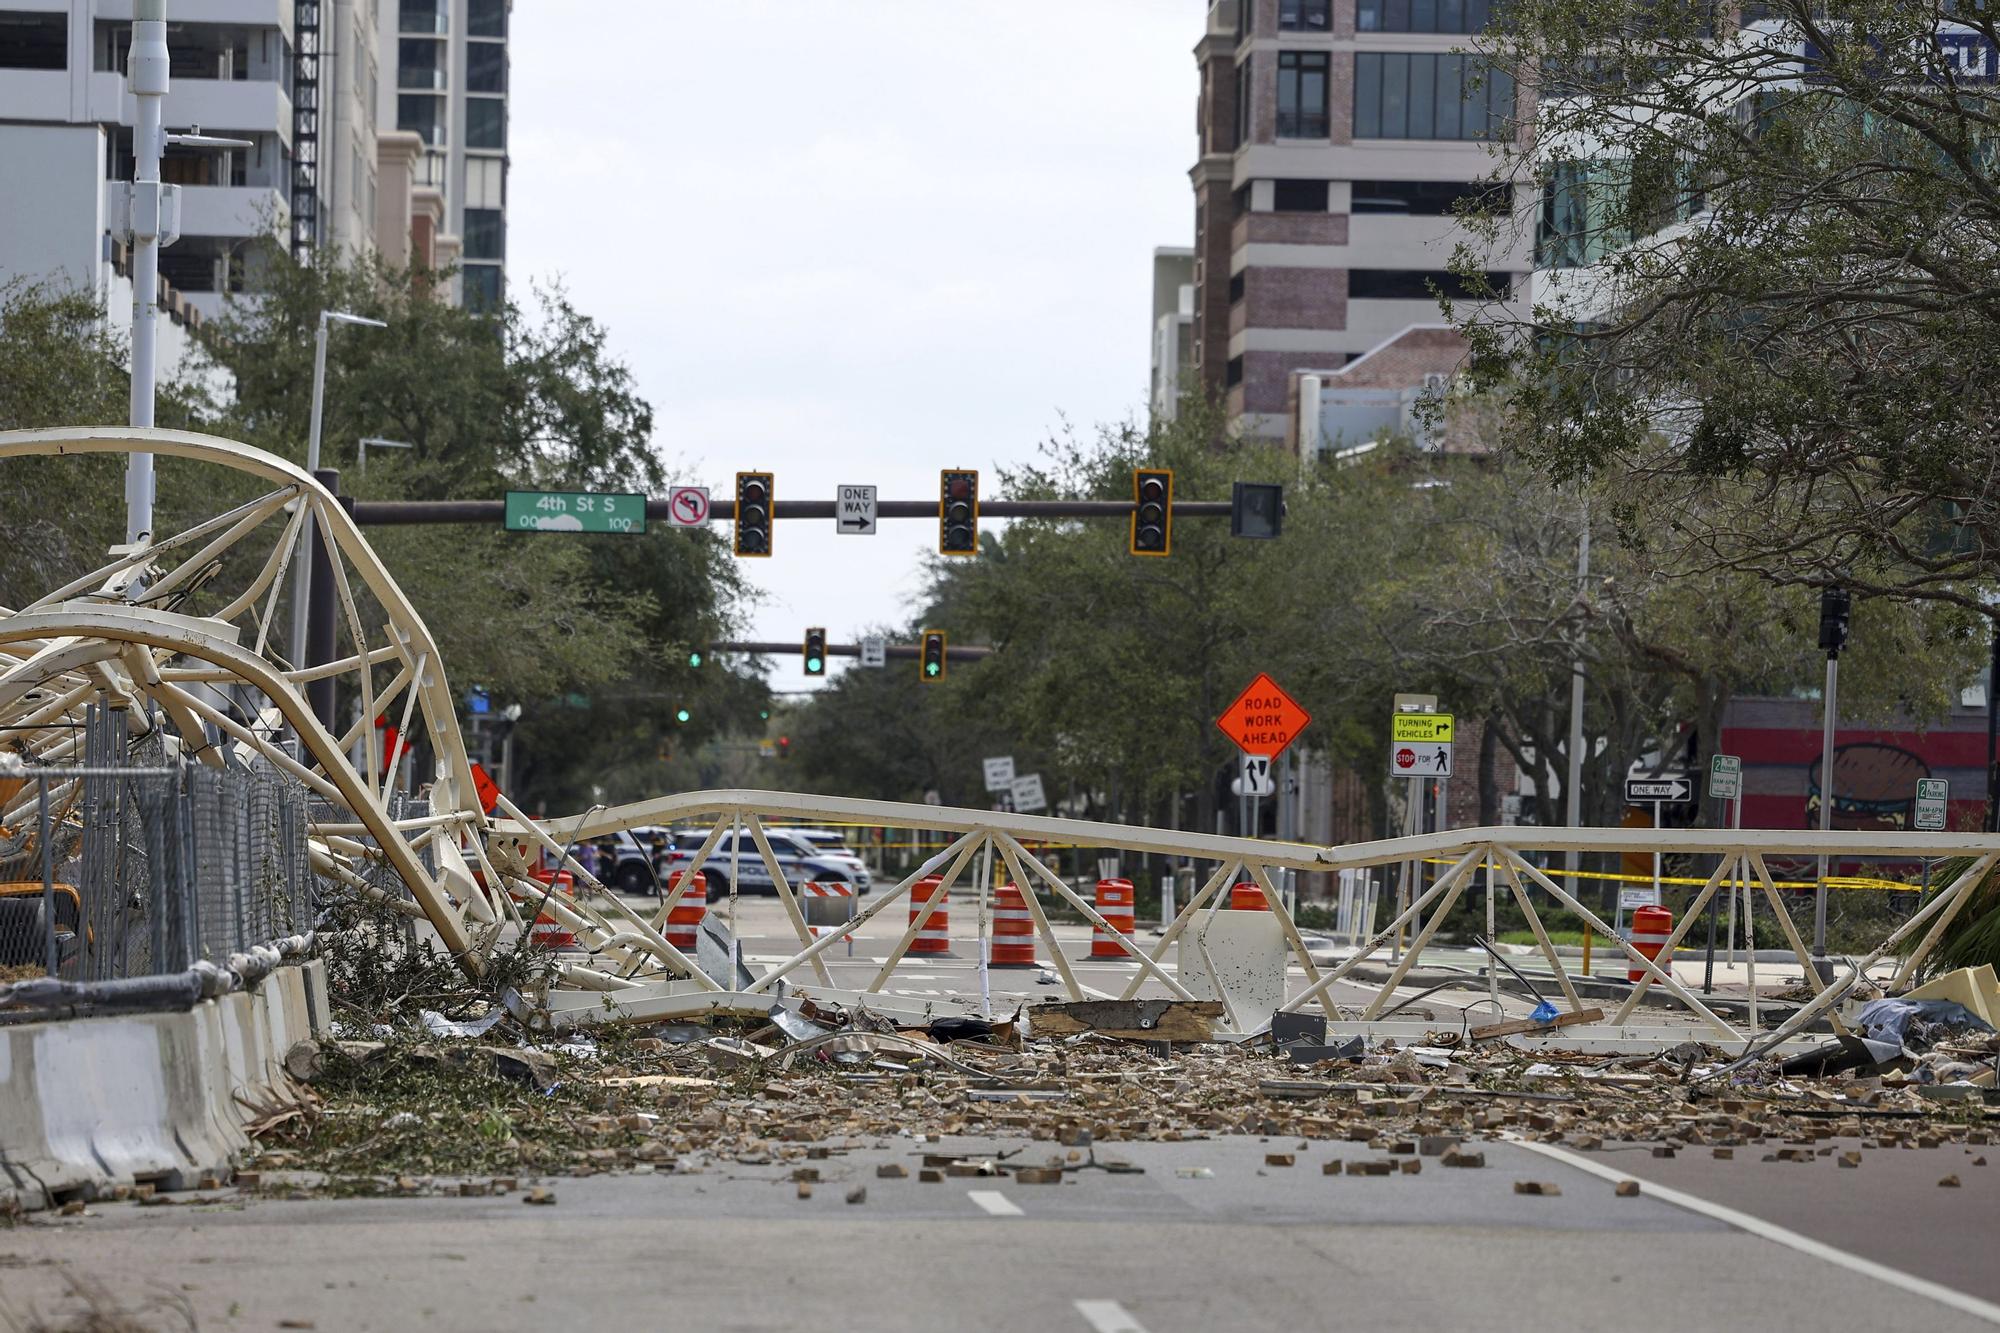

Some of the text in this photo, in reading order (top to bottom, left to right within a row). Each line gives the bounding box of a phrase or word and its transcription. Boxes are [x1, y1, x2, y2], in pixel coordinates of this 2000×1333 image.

[844, 488, 870, 500] ONE
[536, 496, 615, 512] 4th St S
[844, 502, 871, 513] WAY
[519, 515, 632, 530] 00 100
[1245, 697, 1282, 710] ROAD
[1244, 715, 1282, 727] WORK
[1398, 719, 1433, 728] TURNING
[1242, 732, 1287, 744] AHEAD
[1396, 730, 1433, 738] VEHICLES
[1397, 754, 1431, 763] STOP FOR
[1715, 760, 1721, 771] 2
[1633, 786, 1671, 794] ONE WAY
[1920, 784, 1926, 797] 2
[1926, 790, 1944, 798] PARKING
